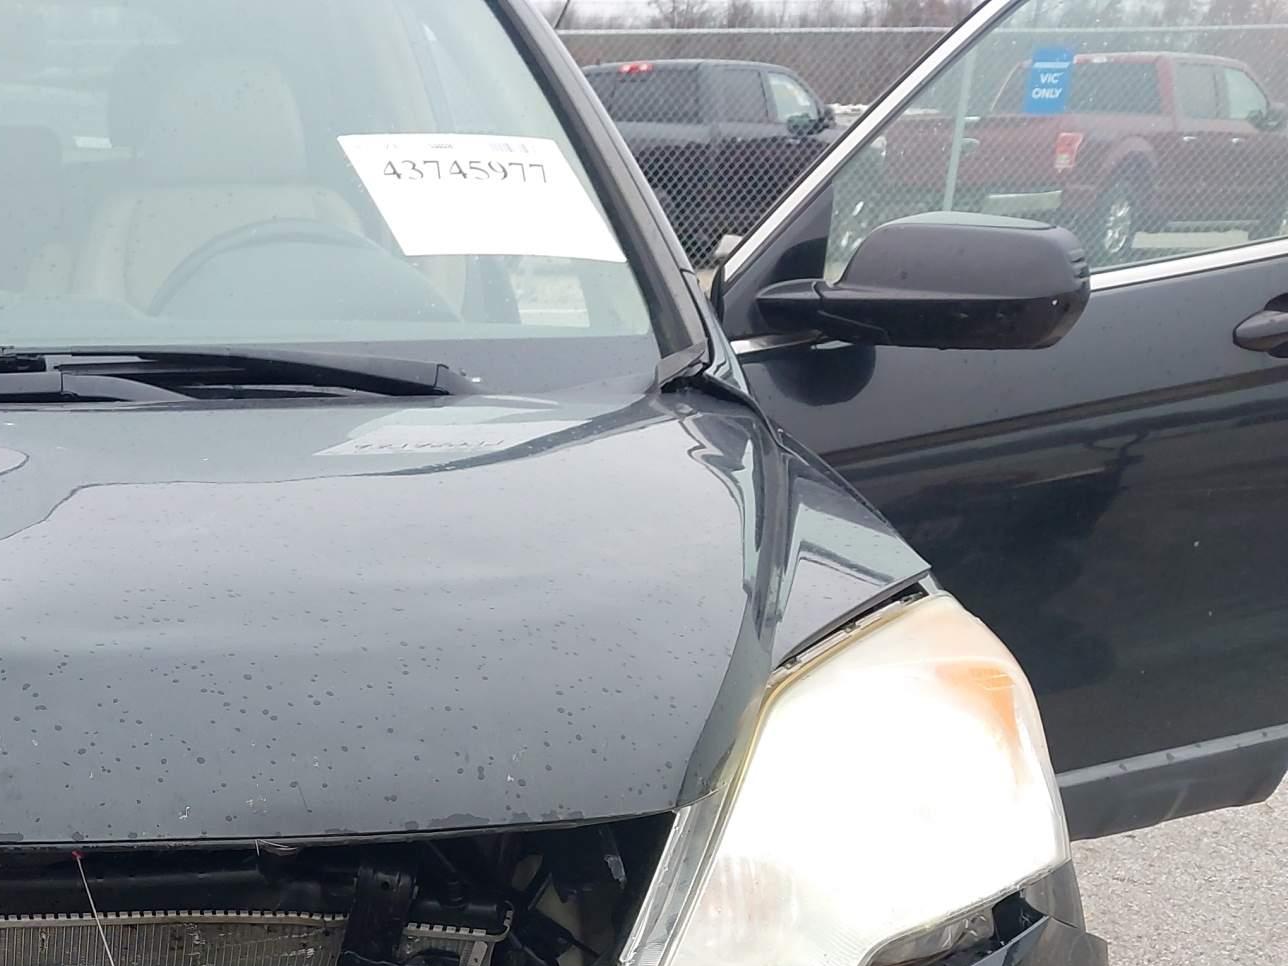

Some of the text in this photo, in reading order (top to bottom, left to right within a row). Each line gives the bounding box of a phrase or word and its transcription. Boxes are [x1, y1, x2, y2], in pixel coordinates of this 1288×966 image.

[1040, 72, 1064, 84] VIC
[1031, 87, 1063, 99] ONLY
[383, 159, 547, 183] 43745977
